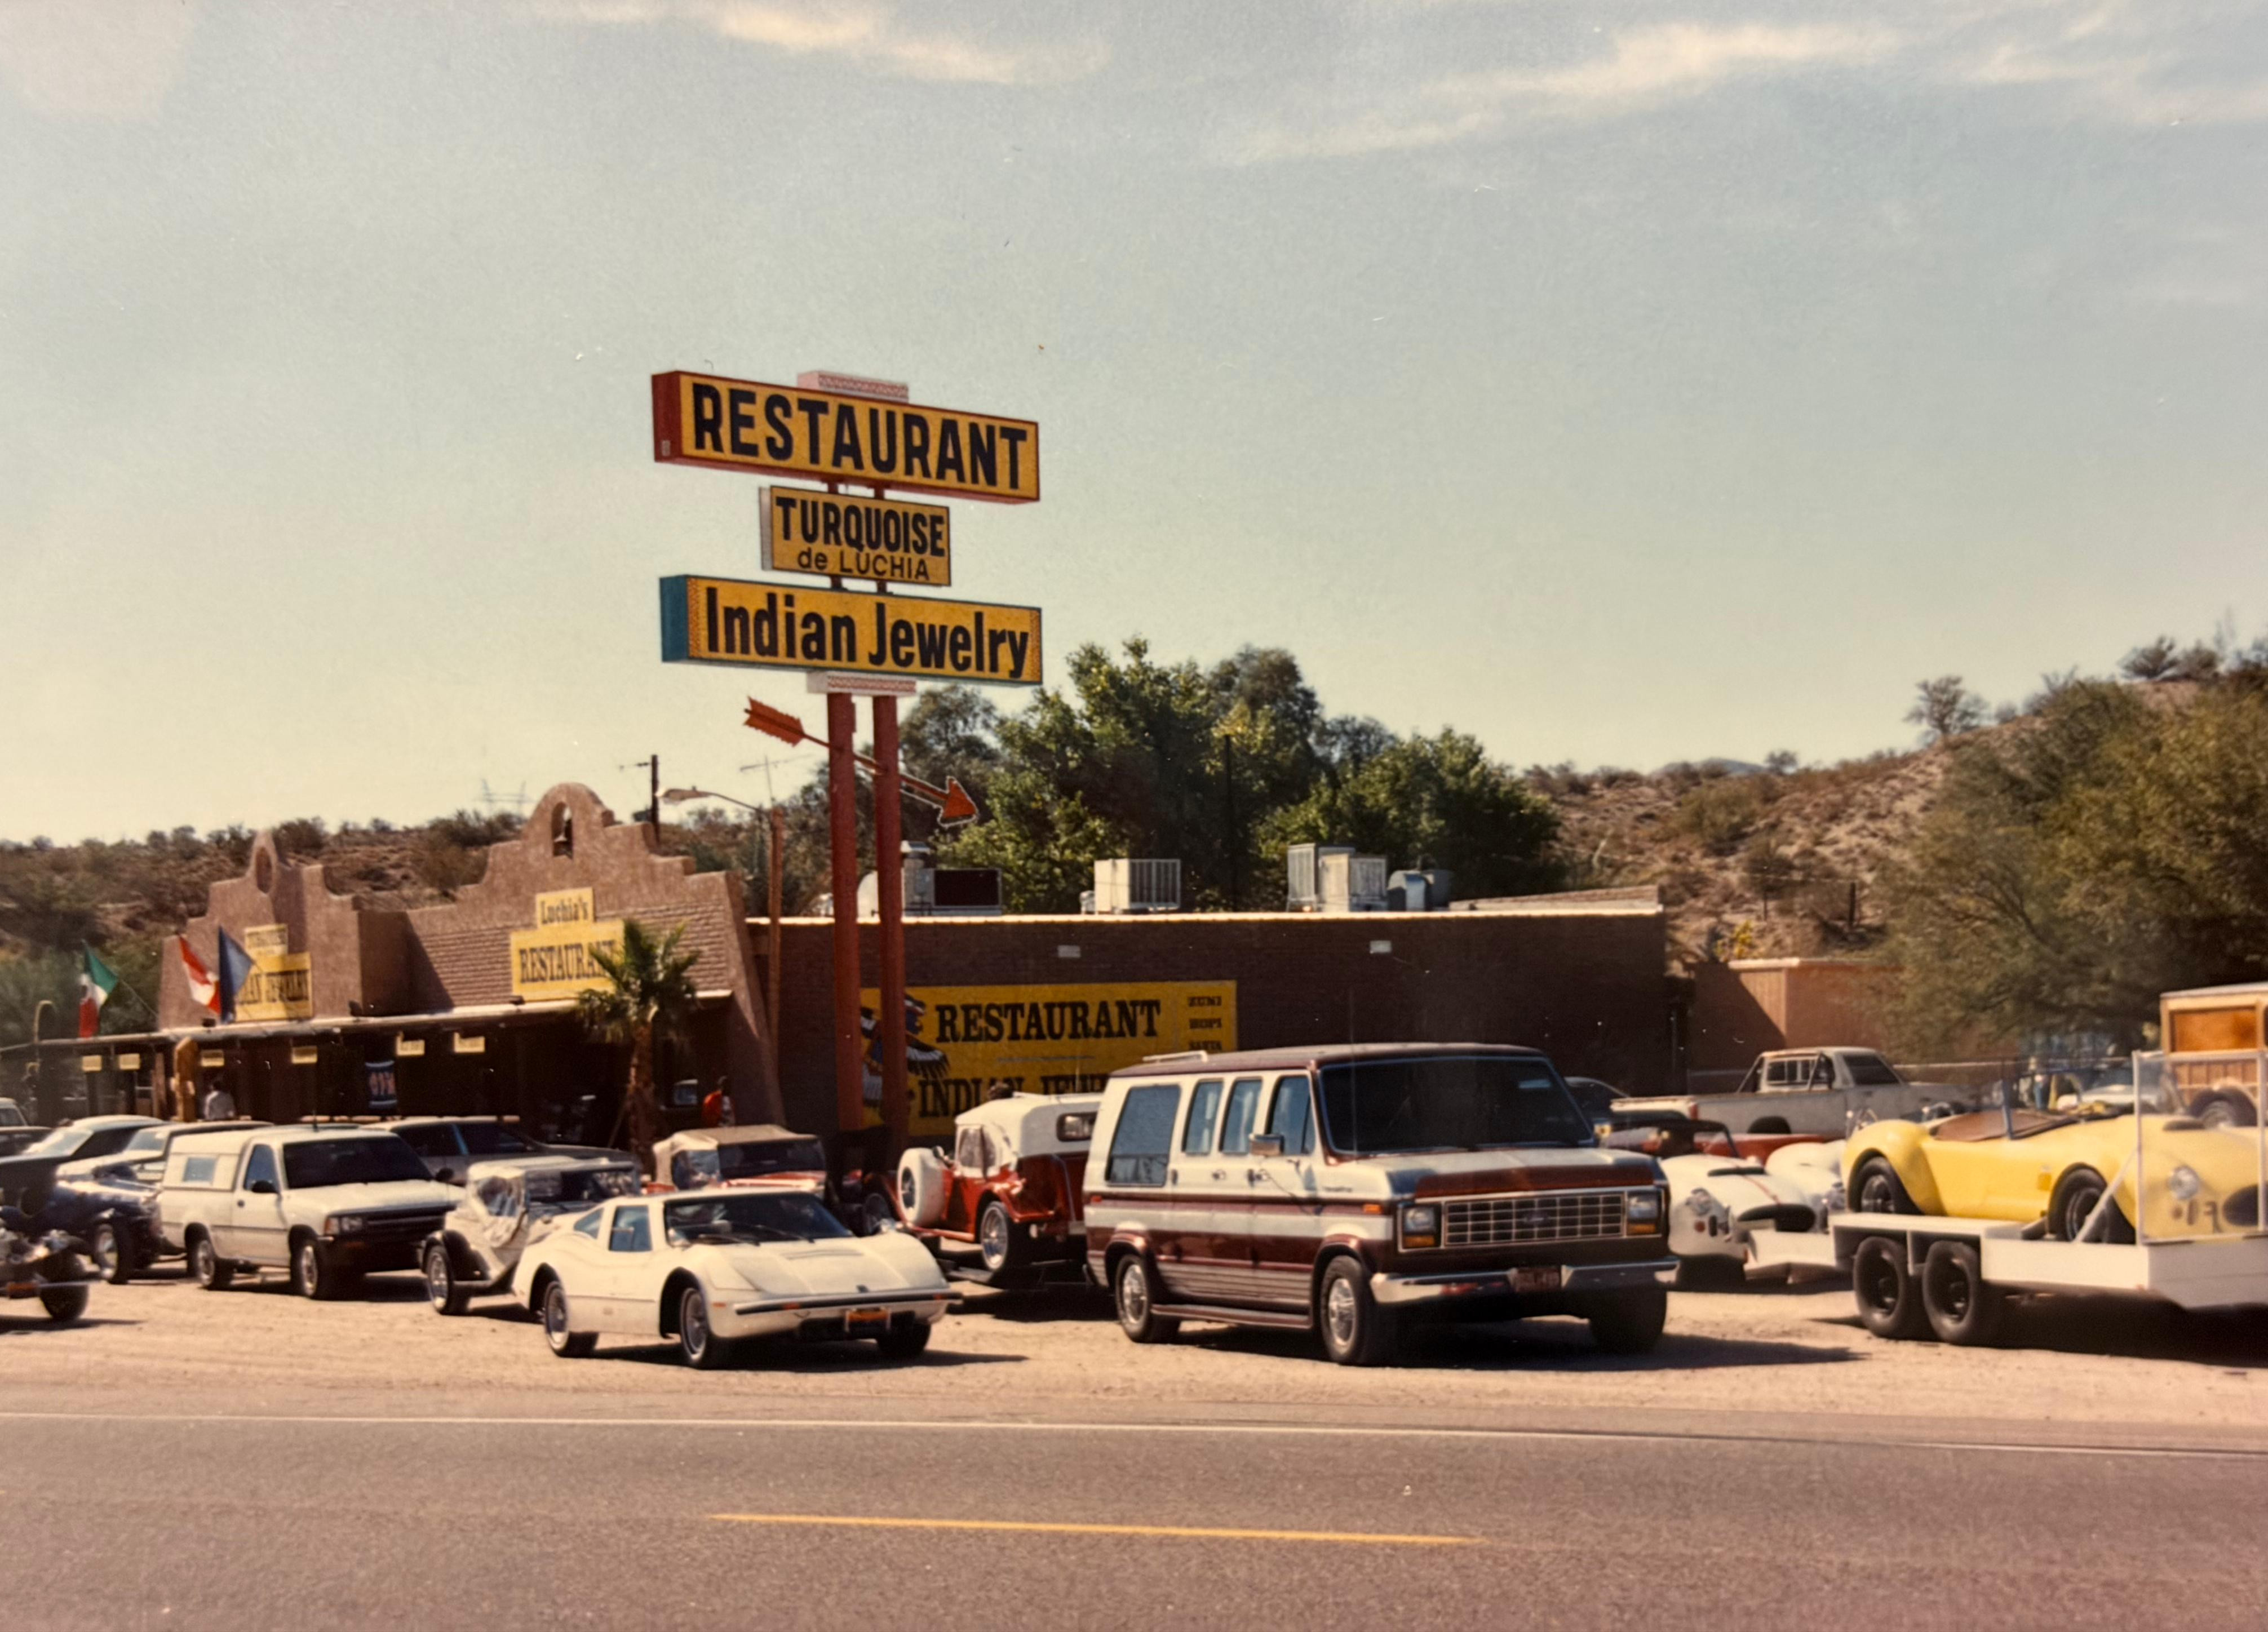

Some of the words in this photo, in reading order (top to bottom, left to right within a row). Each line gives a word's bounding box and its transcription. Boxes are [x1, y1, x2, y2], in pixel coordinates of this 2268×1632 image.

[692, 382, 1027, 490] RESTAURANT
[776, 496, 945, 557] TURQUOISE
[797, 547, 828, 571] de
[839, 551, 930, 581] LUCHIA
[706, 586, 857, 663] Indian
[869, 602, 1030, 680] Jewelry
[936, 999, 1160, 1043] RESTAURANT
[918, 1077, 1024, 1117] INDI
